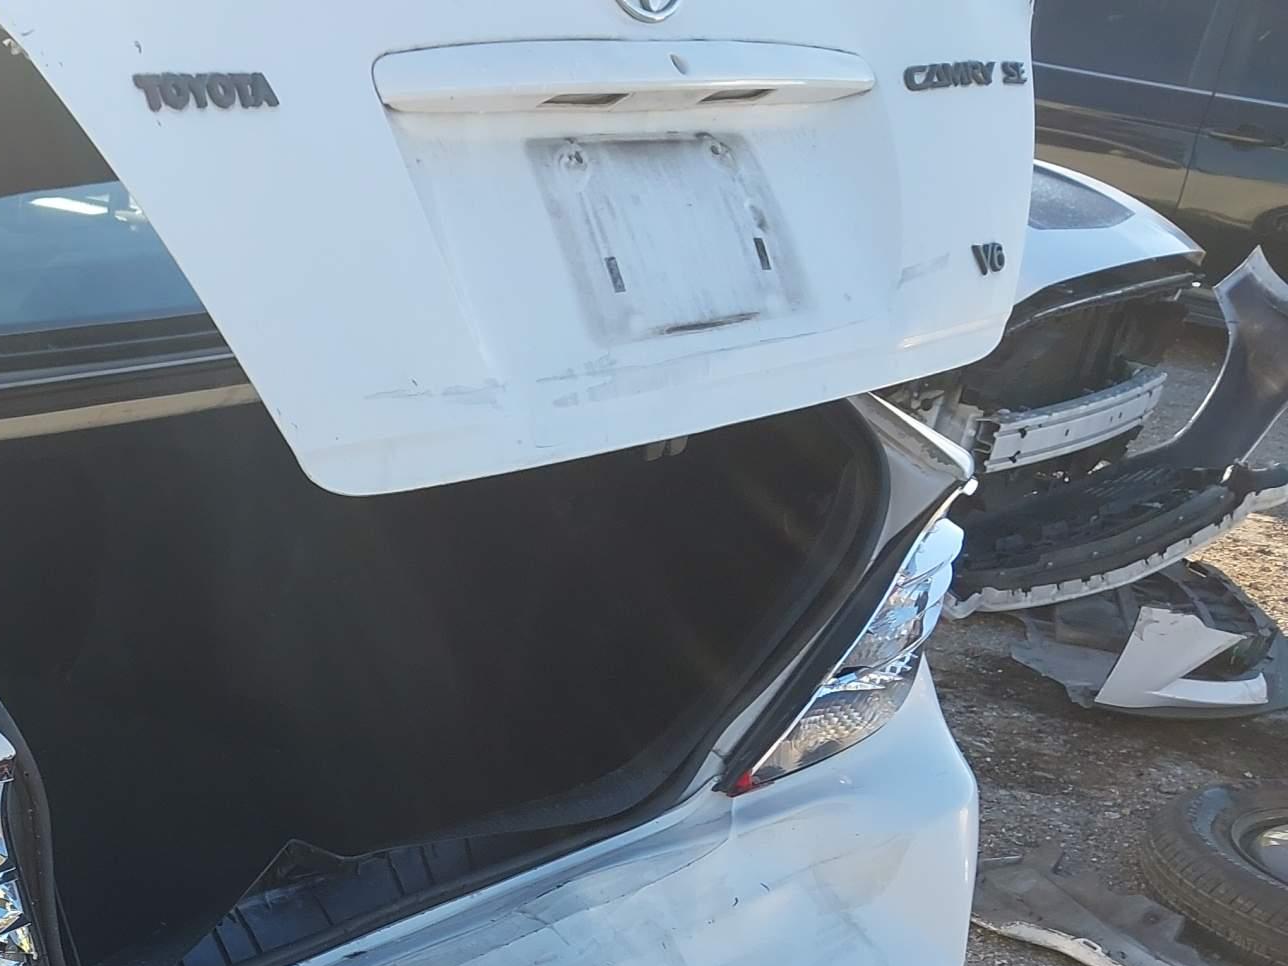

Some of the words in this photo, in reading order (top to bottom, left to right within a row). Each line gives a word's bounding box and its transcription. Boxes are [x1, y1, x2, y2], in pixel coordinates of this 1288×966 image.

[132, 72, 280, 112] TOYOTA
[903, 60, 995, 91] CAMRY
[1000, 60, 1028, 84] SE
[971, 242, 1005, 275] V6
